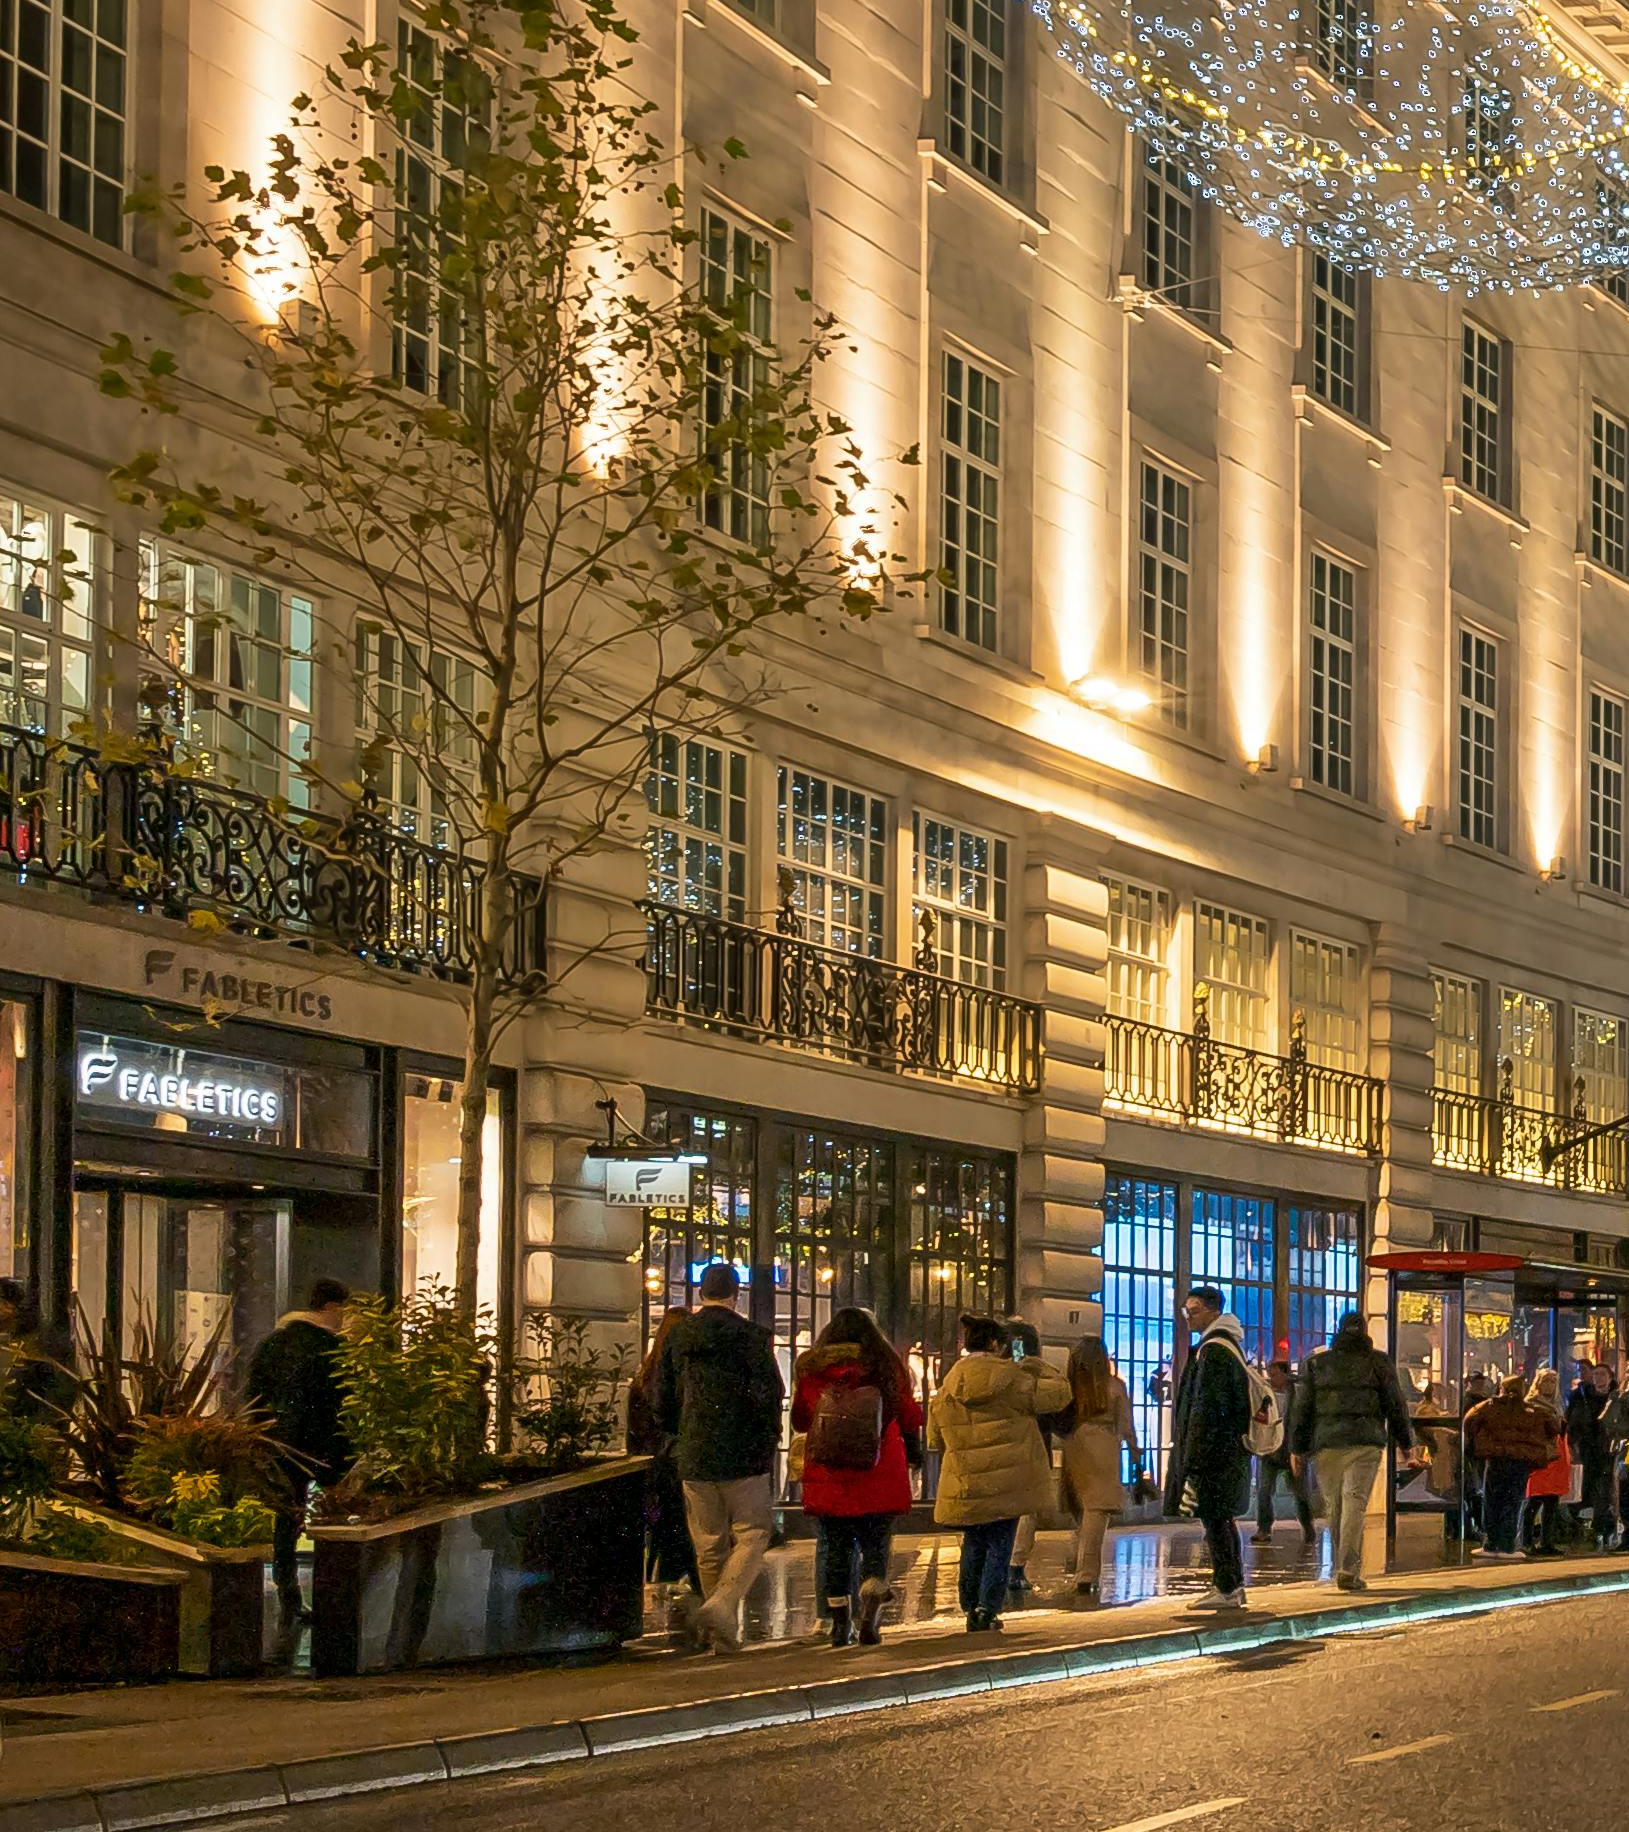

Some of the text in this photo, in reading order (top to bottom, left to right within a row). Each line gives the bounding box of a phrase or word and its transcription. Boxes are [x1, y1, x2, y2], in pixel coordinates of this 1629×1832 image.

[182, 967, 332, 1021] FABLETICS
[119, 1068, 279, 1123] FABLETICS
[609, 1193, 686, 1204] FABLETICS
